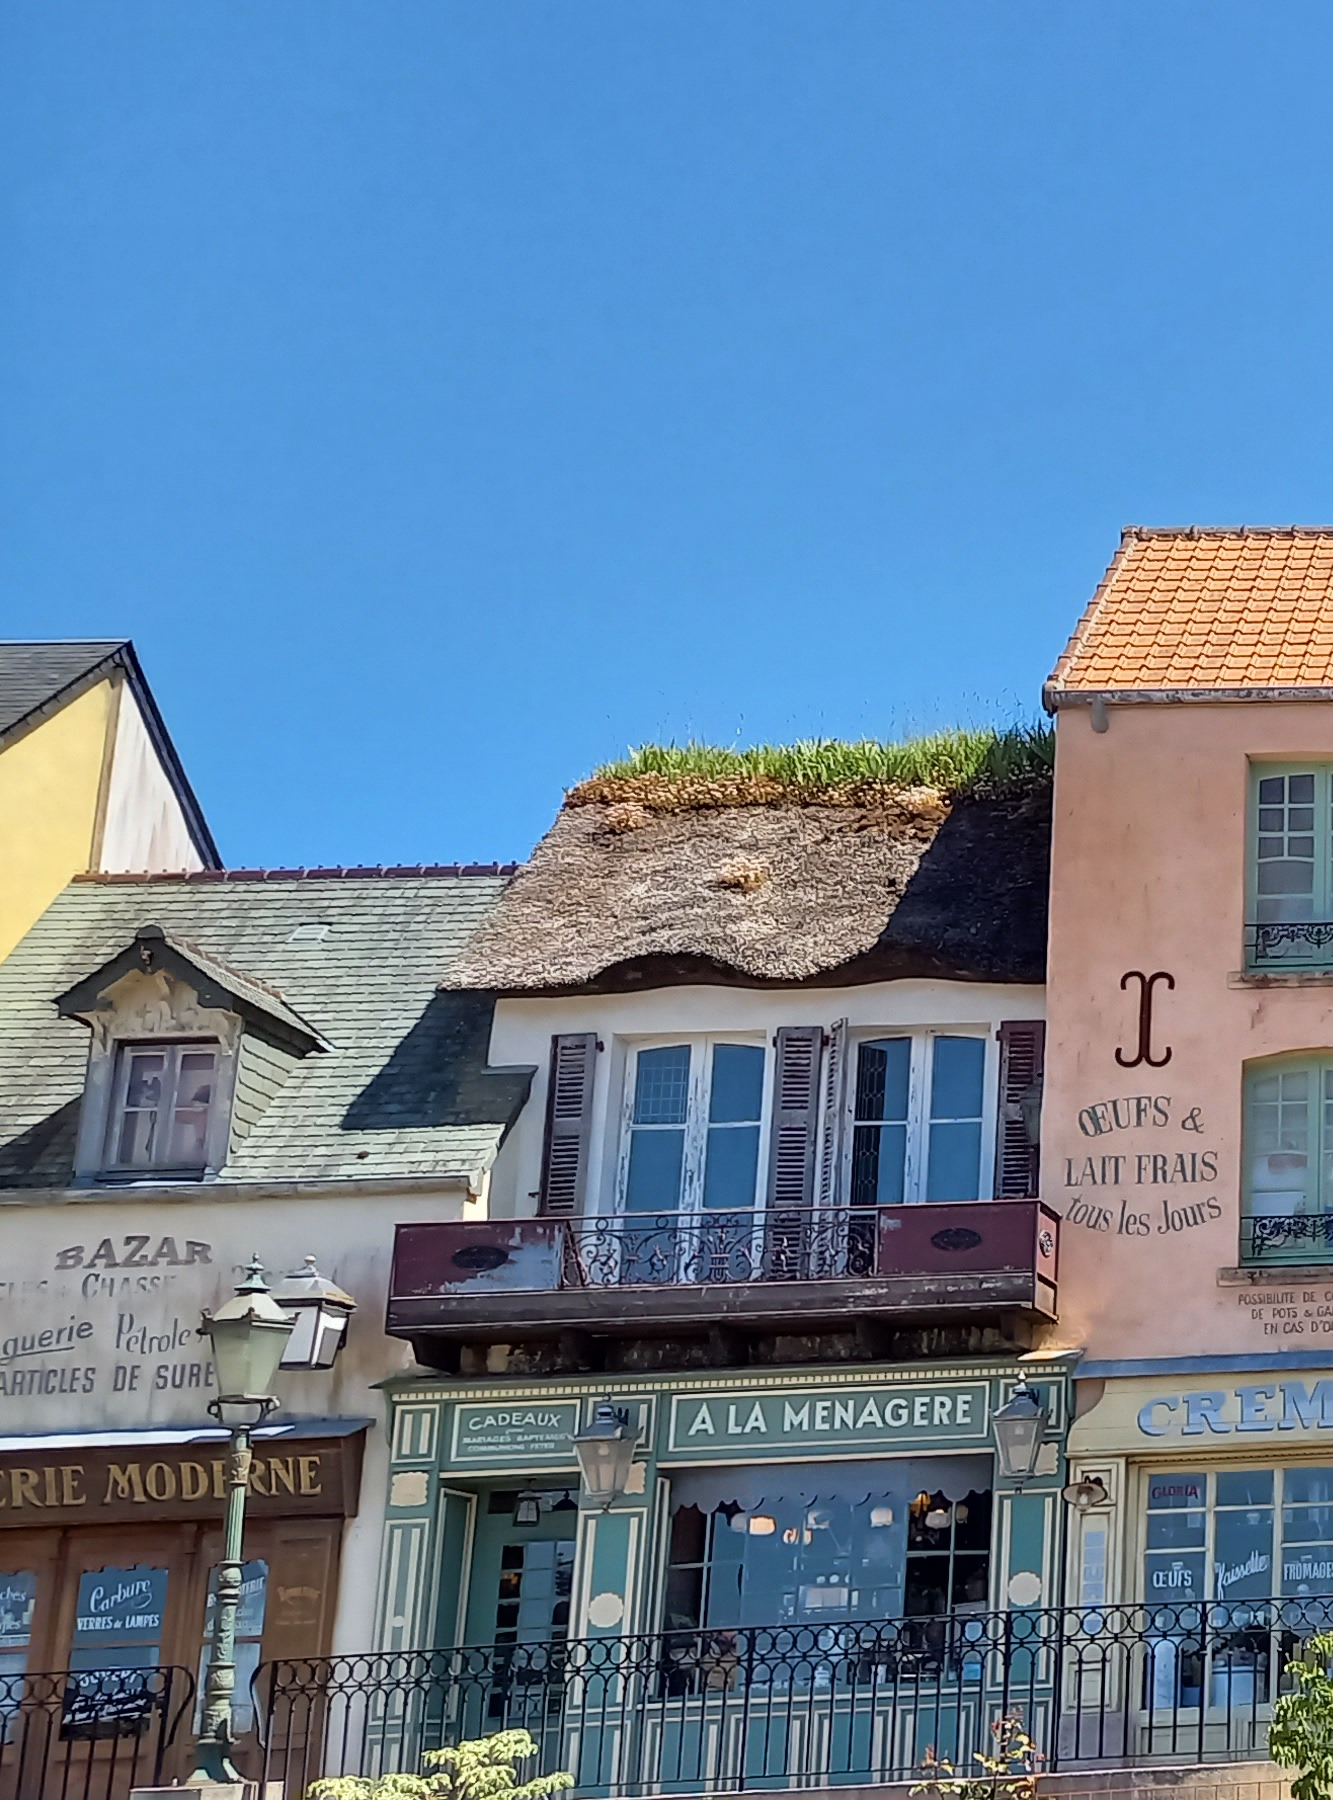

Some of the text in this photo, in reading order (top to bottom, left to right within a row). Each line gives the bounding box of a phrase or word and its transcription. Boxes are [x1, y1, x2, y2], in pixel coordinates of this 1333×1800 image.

[1078, 1095, 1205, 1138] ŒUFS &
[1063, 1150, 1218, 1187] LAIT FRAIS
[1116, 1199, 1151, 1237] les
[54, 1234, 213, 1271] BAZAR
[1238, 1291, 1296, 1306] POSSIBILITE
[1302, 1291, 1317, 1303] DE
[1251, 1308, 1264, 1320] DE
[1272, 1306, 1298, 1319] POTS
[1263, 1322, 1278, 1335] EN
[1282, 1320, 1304, 1334] CAS
[0, 1367, 97, 1396] ARTICLES
[112, 1365, 142, 1392] DE
[468, 1411, 562, 1431] CADEAUX
[688, 1393, 973, 1437] A LA MENAGERE
[1151, 1485, 1199, 1499] GLORIA
[90, 1579, 153, 1613] Carbure
[77, 1616, 113, 1631] VERRES
[125, 1614, 160, 1629] LAMPES
